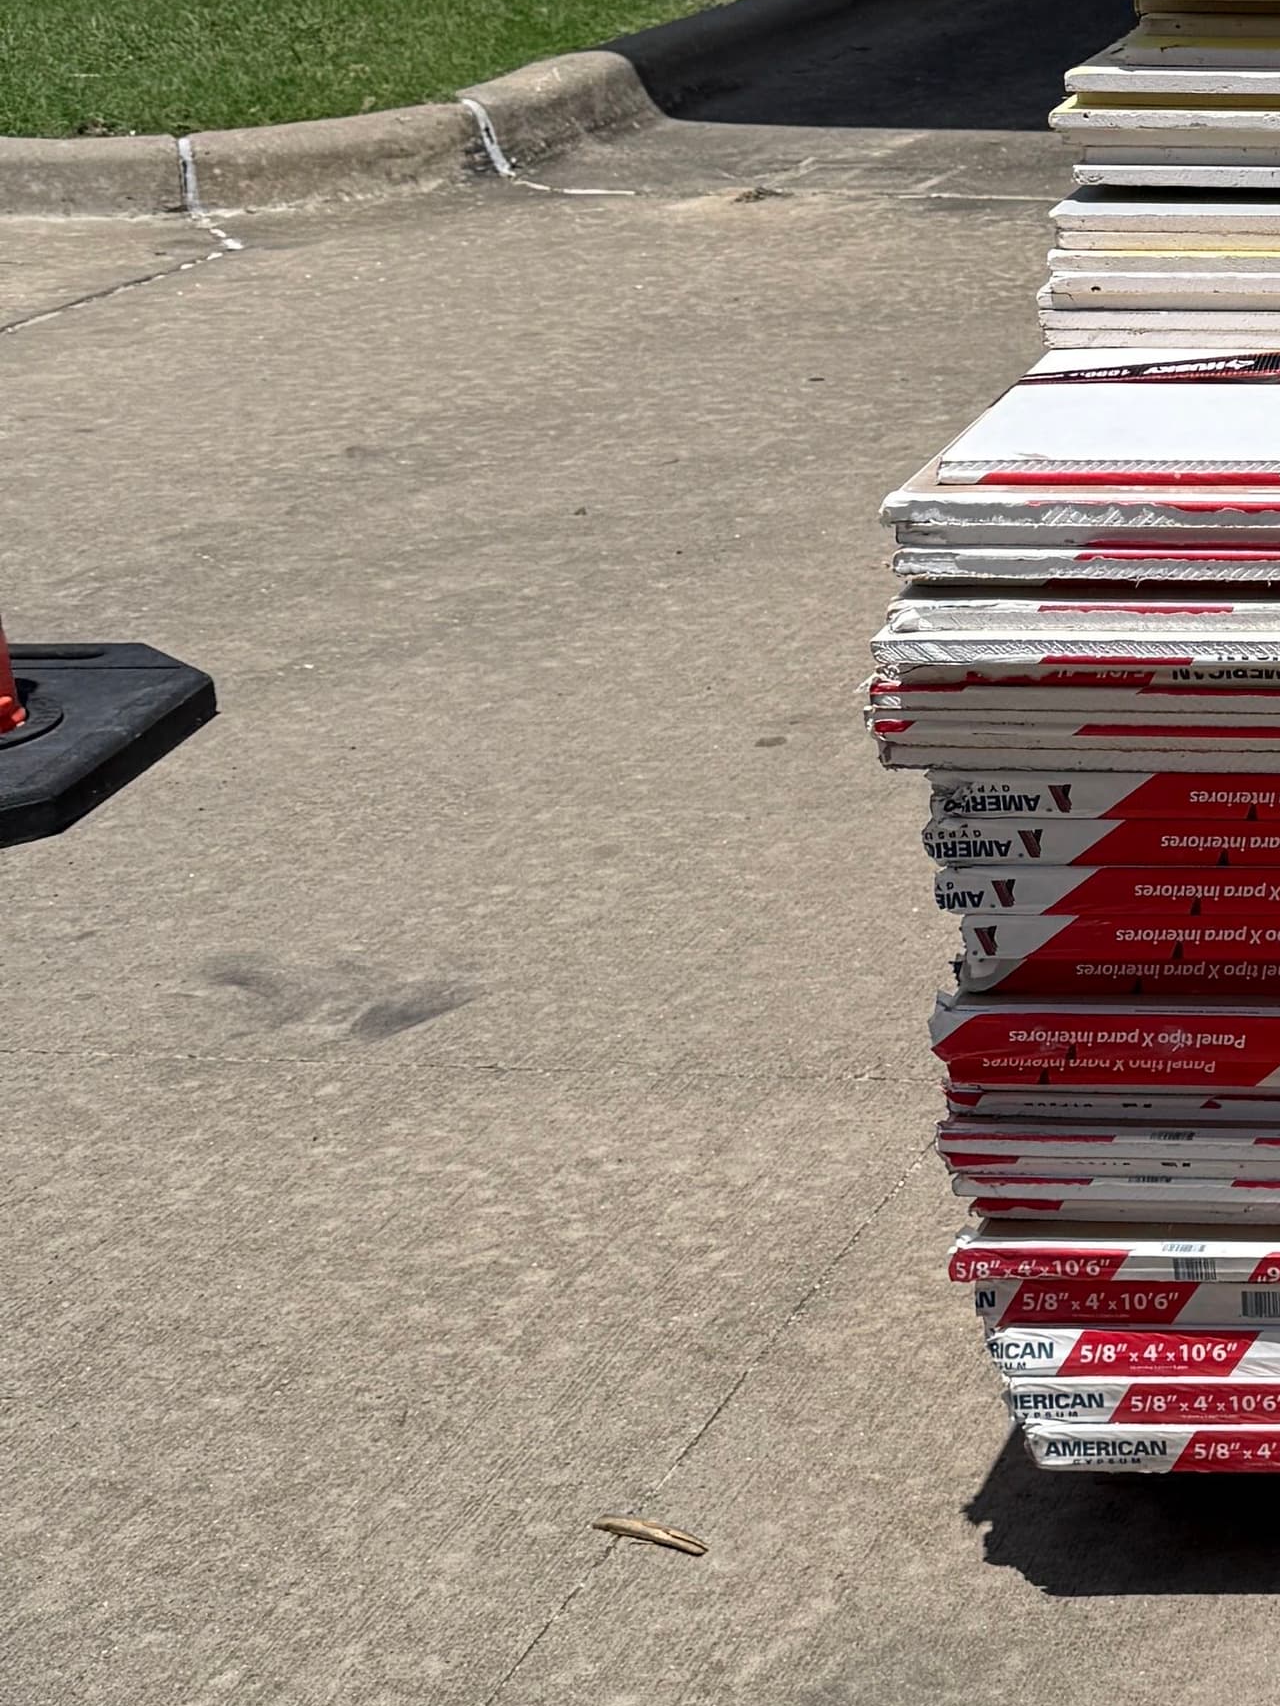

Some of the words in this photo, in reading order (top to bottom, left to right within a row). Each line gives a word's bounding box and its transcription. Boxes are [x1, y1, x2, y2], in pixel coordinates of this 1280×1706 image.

[1190, 791, 1275, 807] interiores
[1116, 929, 1201, 945] interiores
[1205, 926, 1247, 941] para
[1249, 930, 1263, 944] X
[1009, 1030, 1093, 1047] interiores
[1097, 1029, 1139, 1043] para
[1141, 1032, 1154, 1047] X
[1158, 1029, 1194, 1050] tipo
[1196, 1034, 1246, 1049] Panel
[1179, 1403, 1189, 1411] x
[1216, 1402, 1225, 1411] x
[1044, 1438, 1167, 1456] AMERICAN
[1072, 1457, 1142, 1465] GYPSUM
